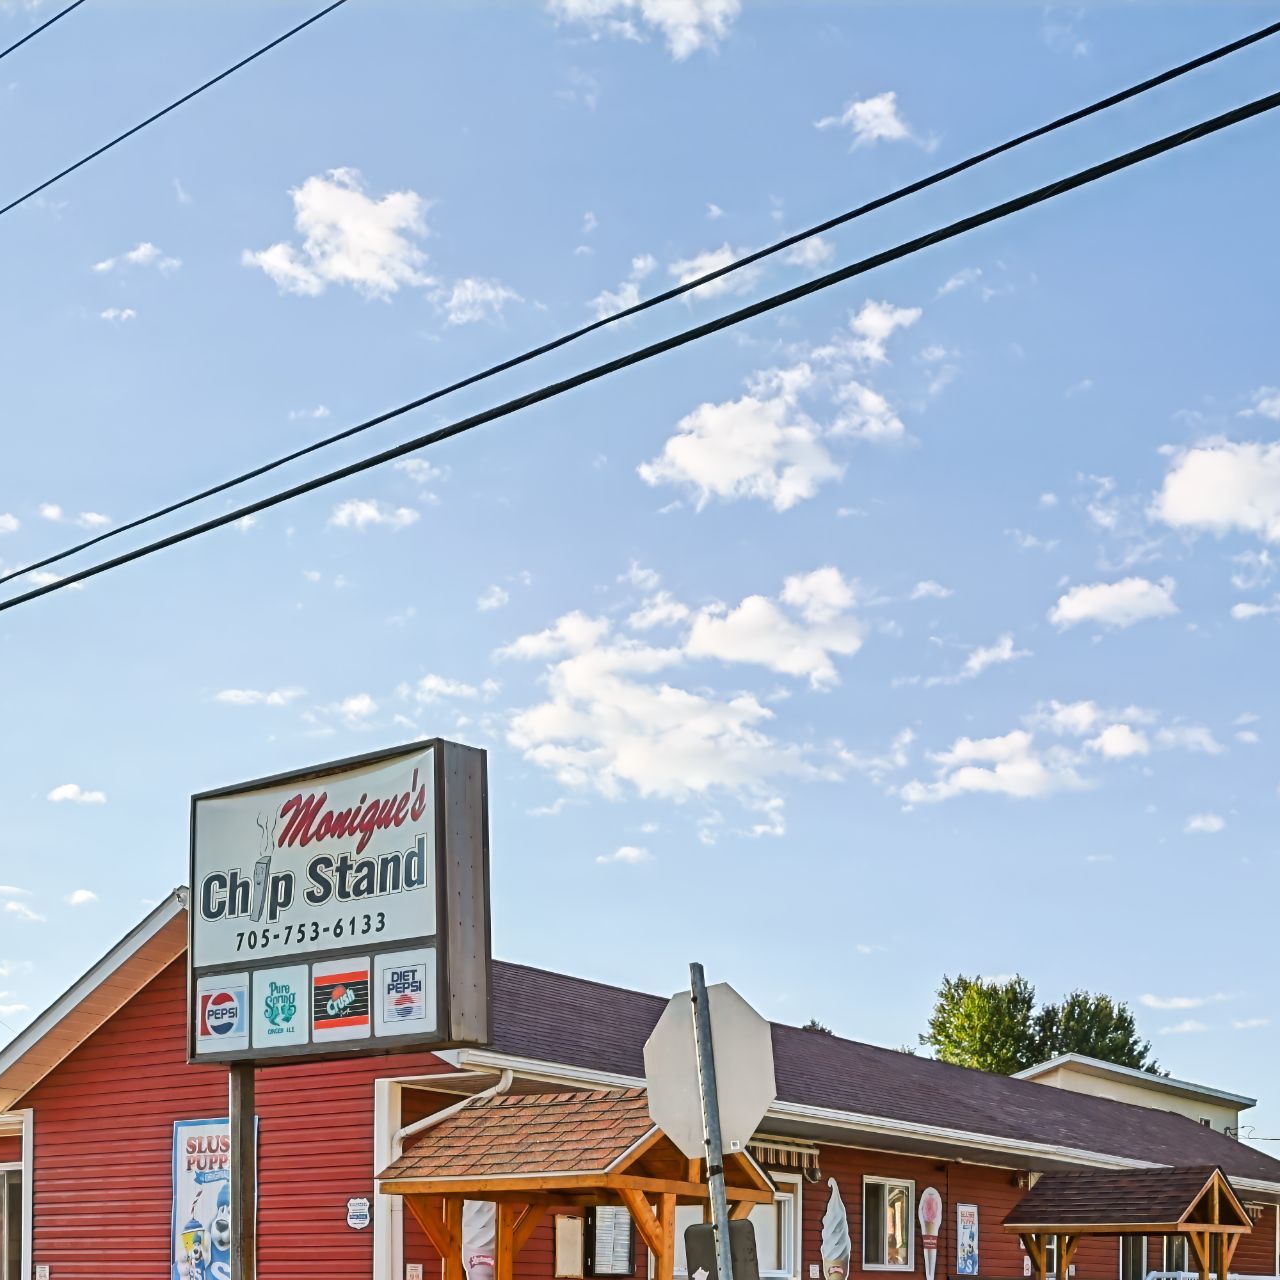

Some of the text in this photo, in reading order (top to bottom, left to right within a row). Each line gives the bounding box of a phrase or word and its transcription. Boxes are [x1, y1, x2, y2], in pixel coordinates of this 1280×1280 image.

[277, 767, 426, 854] Monique's
[200, 833, 428, 924] Chip Stand
[236, 912, 386, 951] 705-753-6133
[391, 969, 417, 982] DIET
[269, 981, 290, 996] Pure
[387, 980, 421, 994] PEPSI
[264, 992, 296, 1018] Spring
[327, 987, 355, 1016] Crush
[207, 1006, 238, 1020] PEPSI
[186, 1134, 231, 1154] SLUS
[186, 1154, 229, 1171] PUPP
